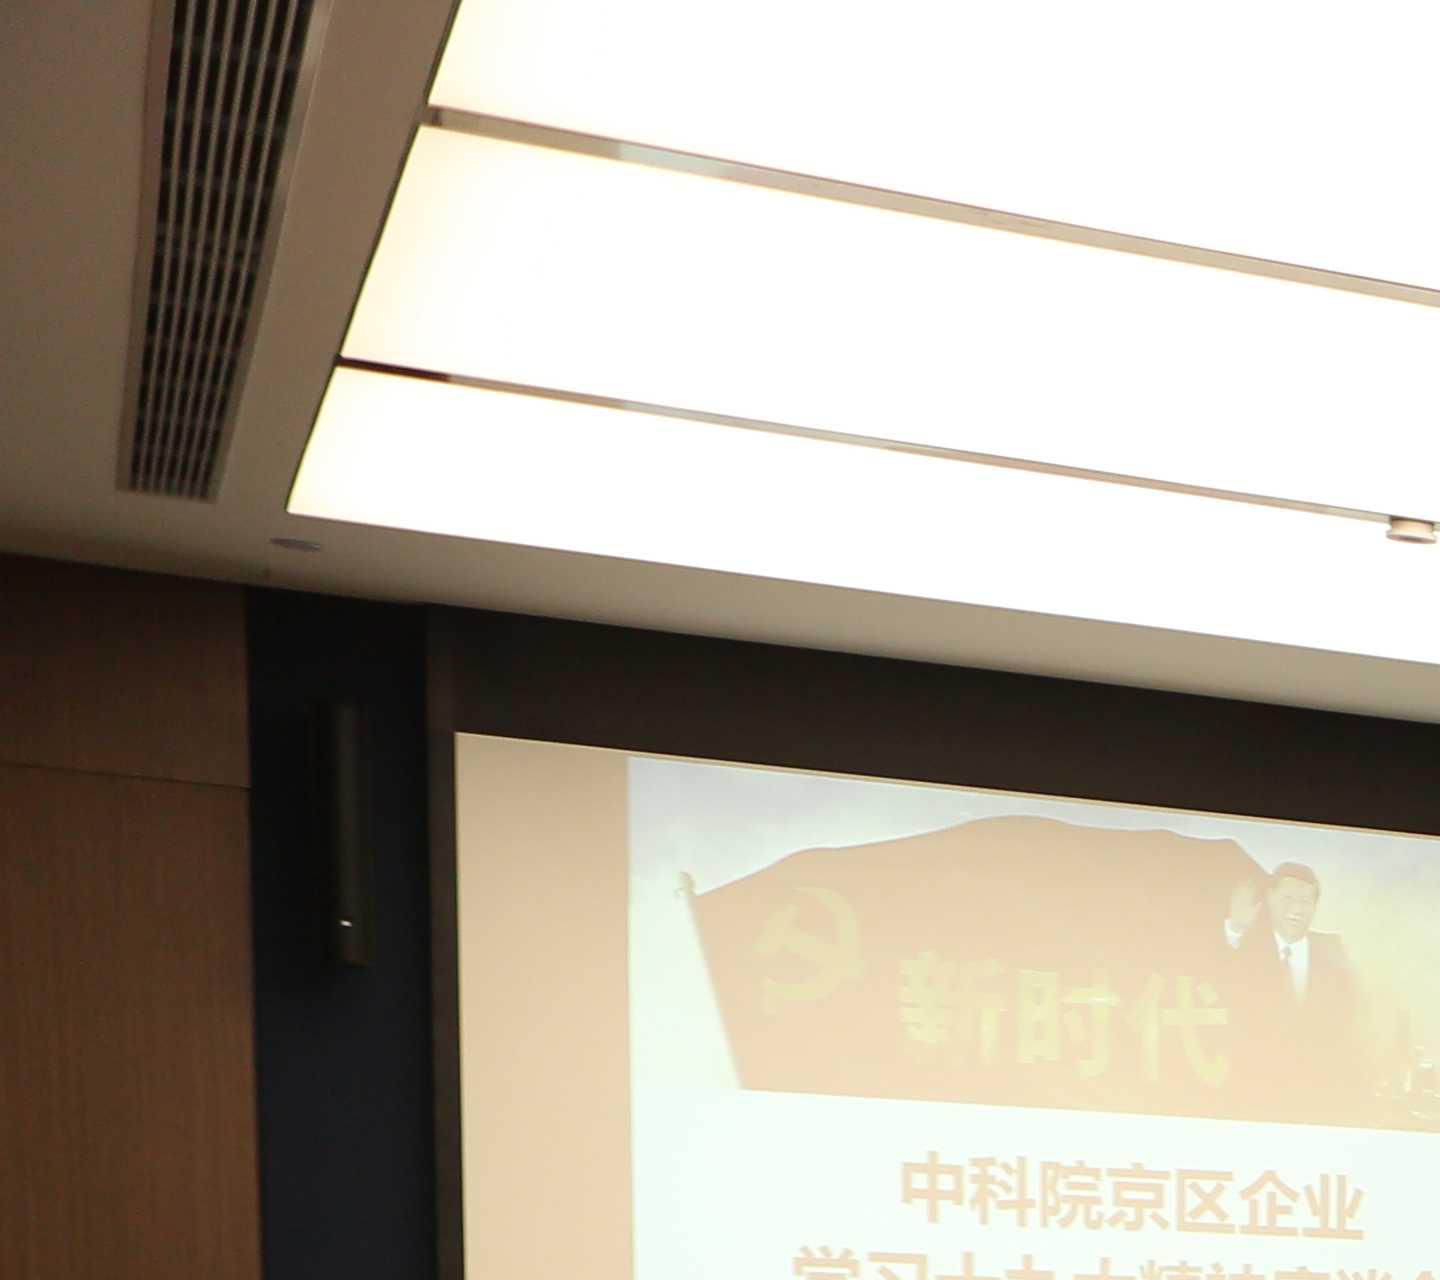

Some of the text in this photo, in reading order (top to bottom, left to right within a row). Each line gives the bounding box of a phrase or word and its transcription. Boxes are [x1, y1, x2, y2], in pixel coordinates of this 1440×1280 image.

[896, 950, 1230, 1086] 新时代
[899, 1150, 1366, 1242] 中科院京区企业
